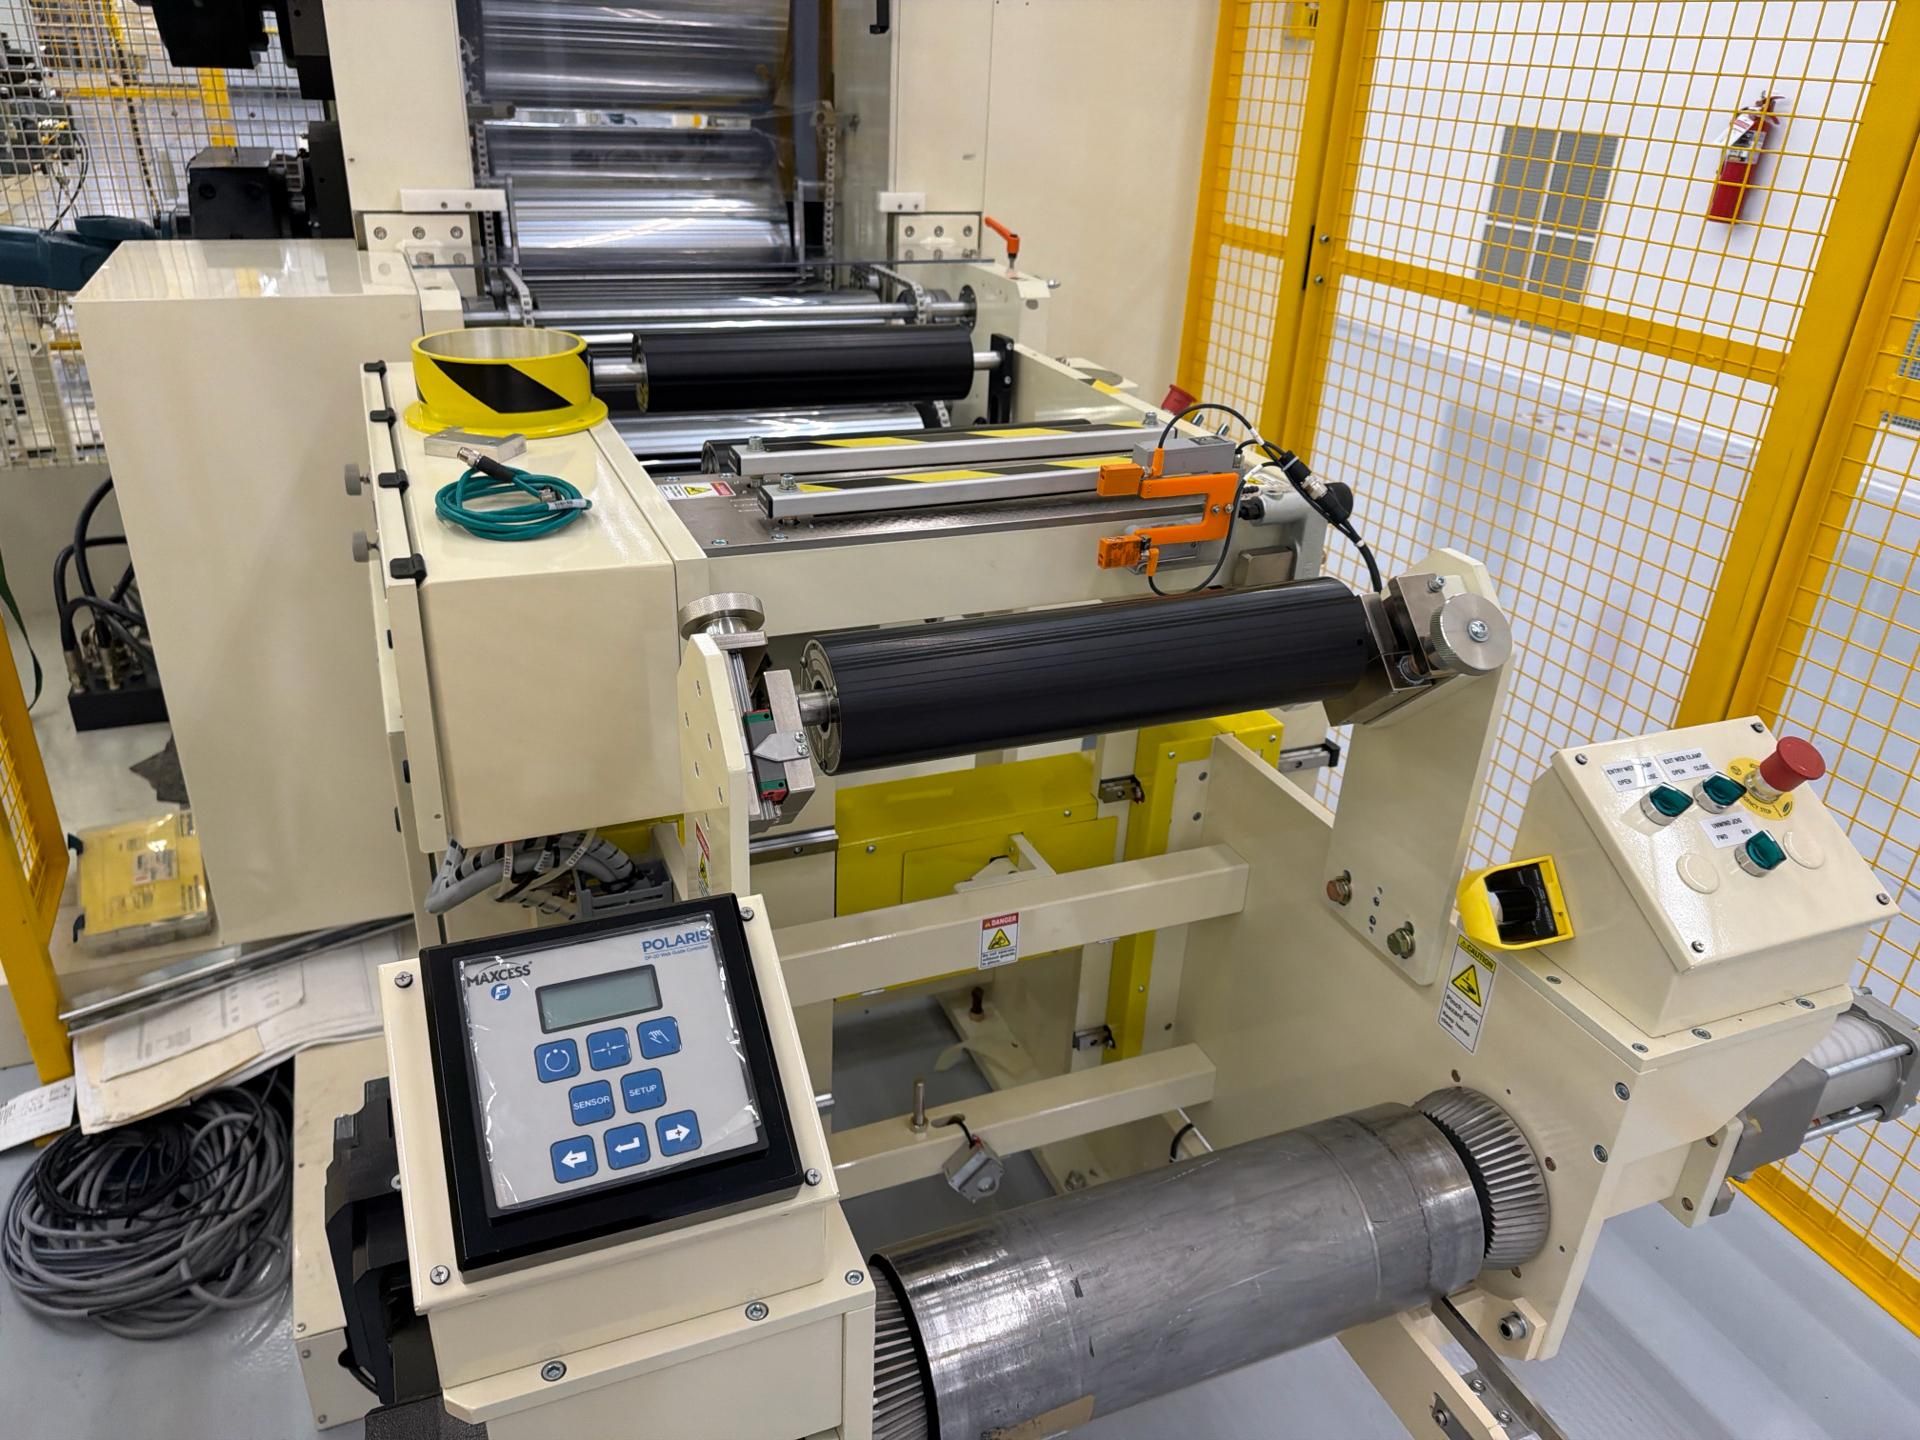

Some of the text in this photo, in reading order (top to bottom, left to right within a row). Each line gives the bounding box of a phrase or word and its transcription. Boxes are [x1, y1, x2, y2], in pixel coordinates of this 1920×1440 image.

[1671, 768, 1686, 776] OPEN
[1617, 778, 1632, 786] OPEN
[991, 915, 1016, 926] DANGER
[642, 930, 709, 952] POLARIS
[1466, 945, 1494, 970] CAUTION
[466, 964, 531, 987] MAXCESS
[629, 1084, 657, 1097] SETUP
[573, 1095, 610, 1111] SENSOR
